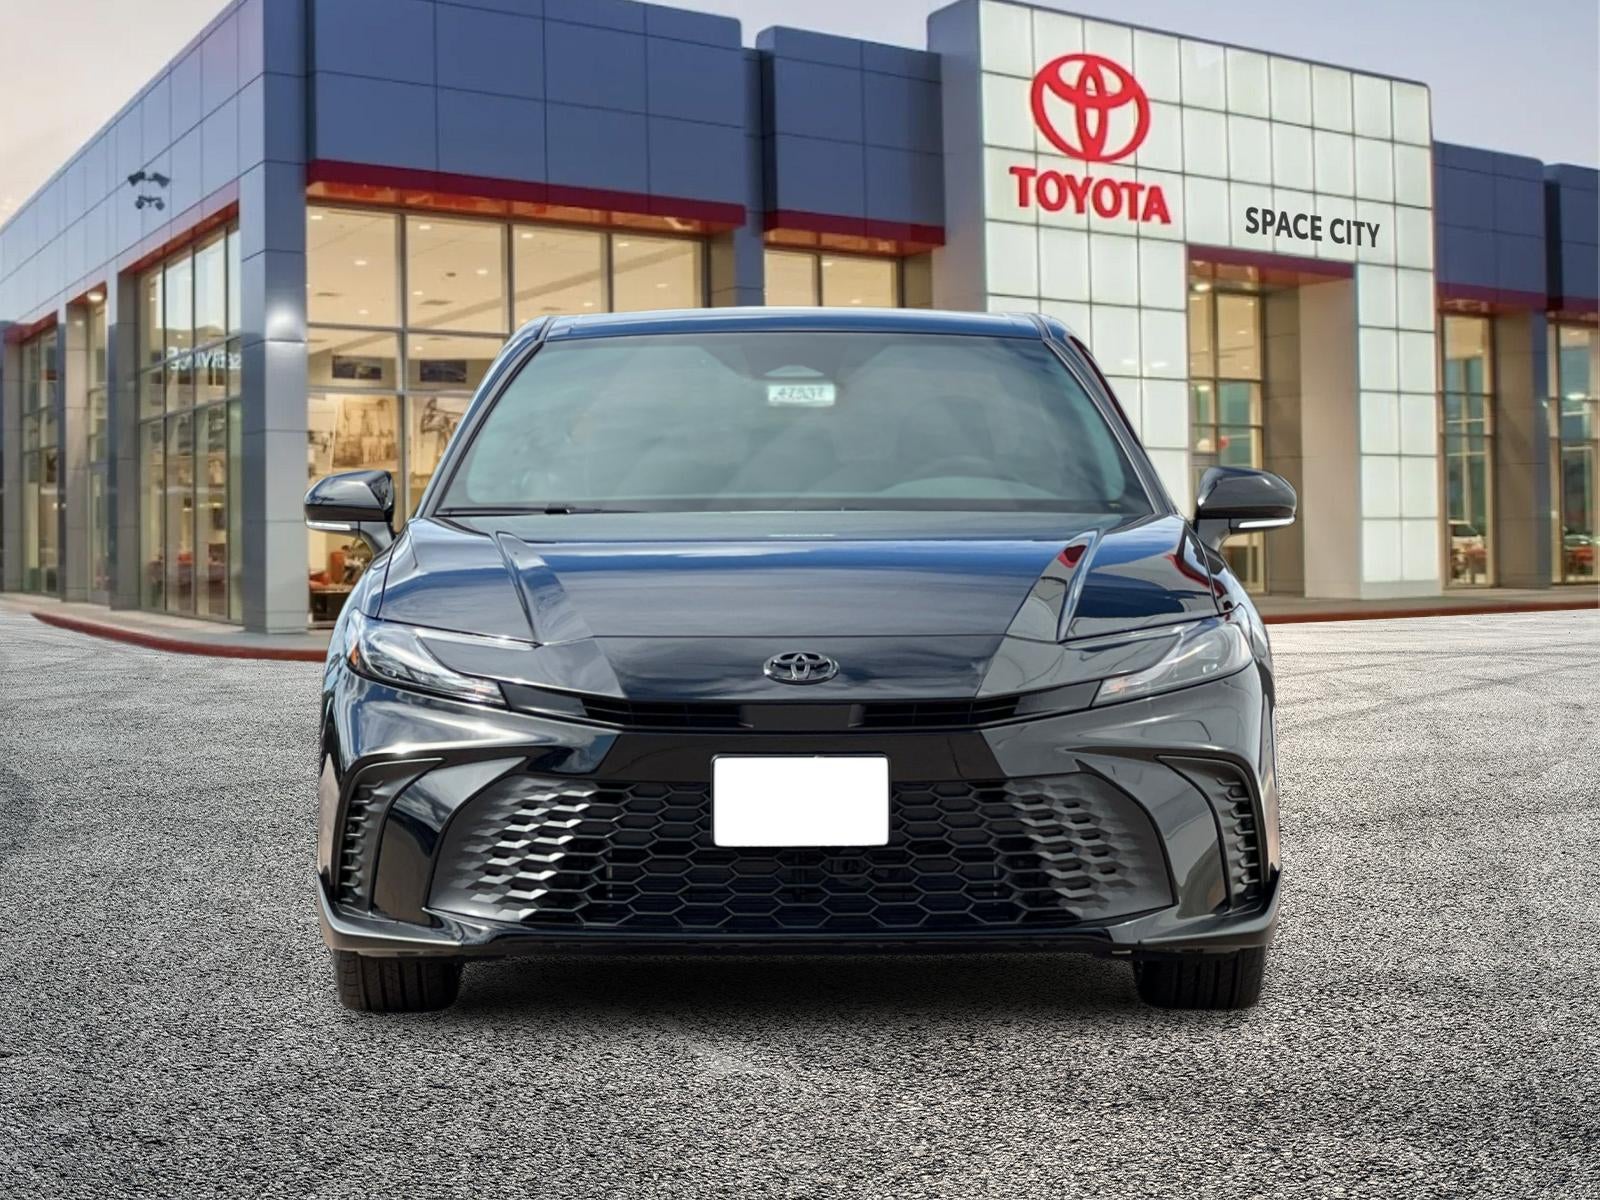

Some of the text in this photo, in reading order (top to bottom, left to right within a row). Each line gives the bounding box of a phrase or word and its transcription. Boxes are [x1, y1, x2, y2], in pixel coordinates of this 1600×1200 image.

[1009, 166, 1171, 224] TOYOTA
[1245, 207, 1381, 248] SPACE CITY
